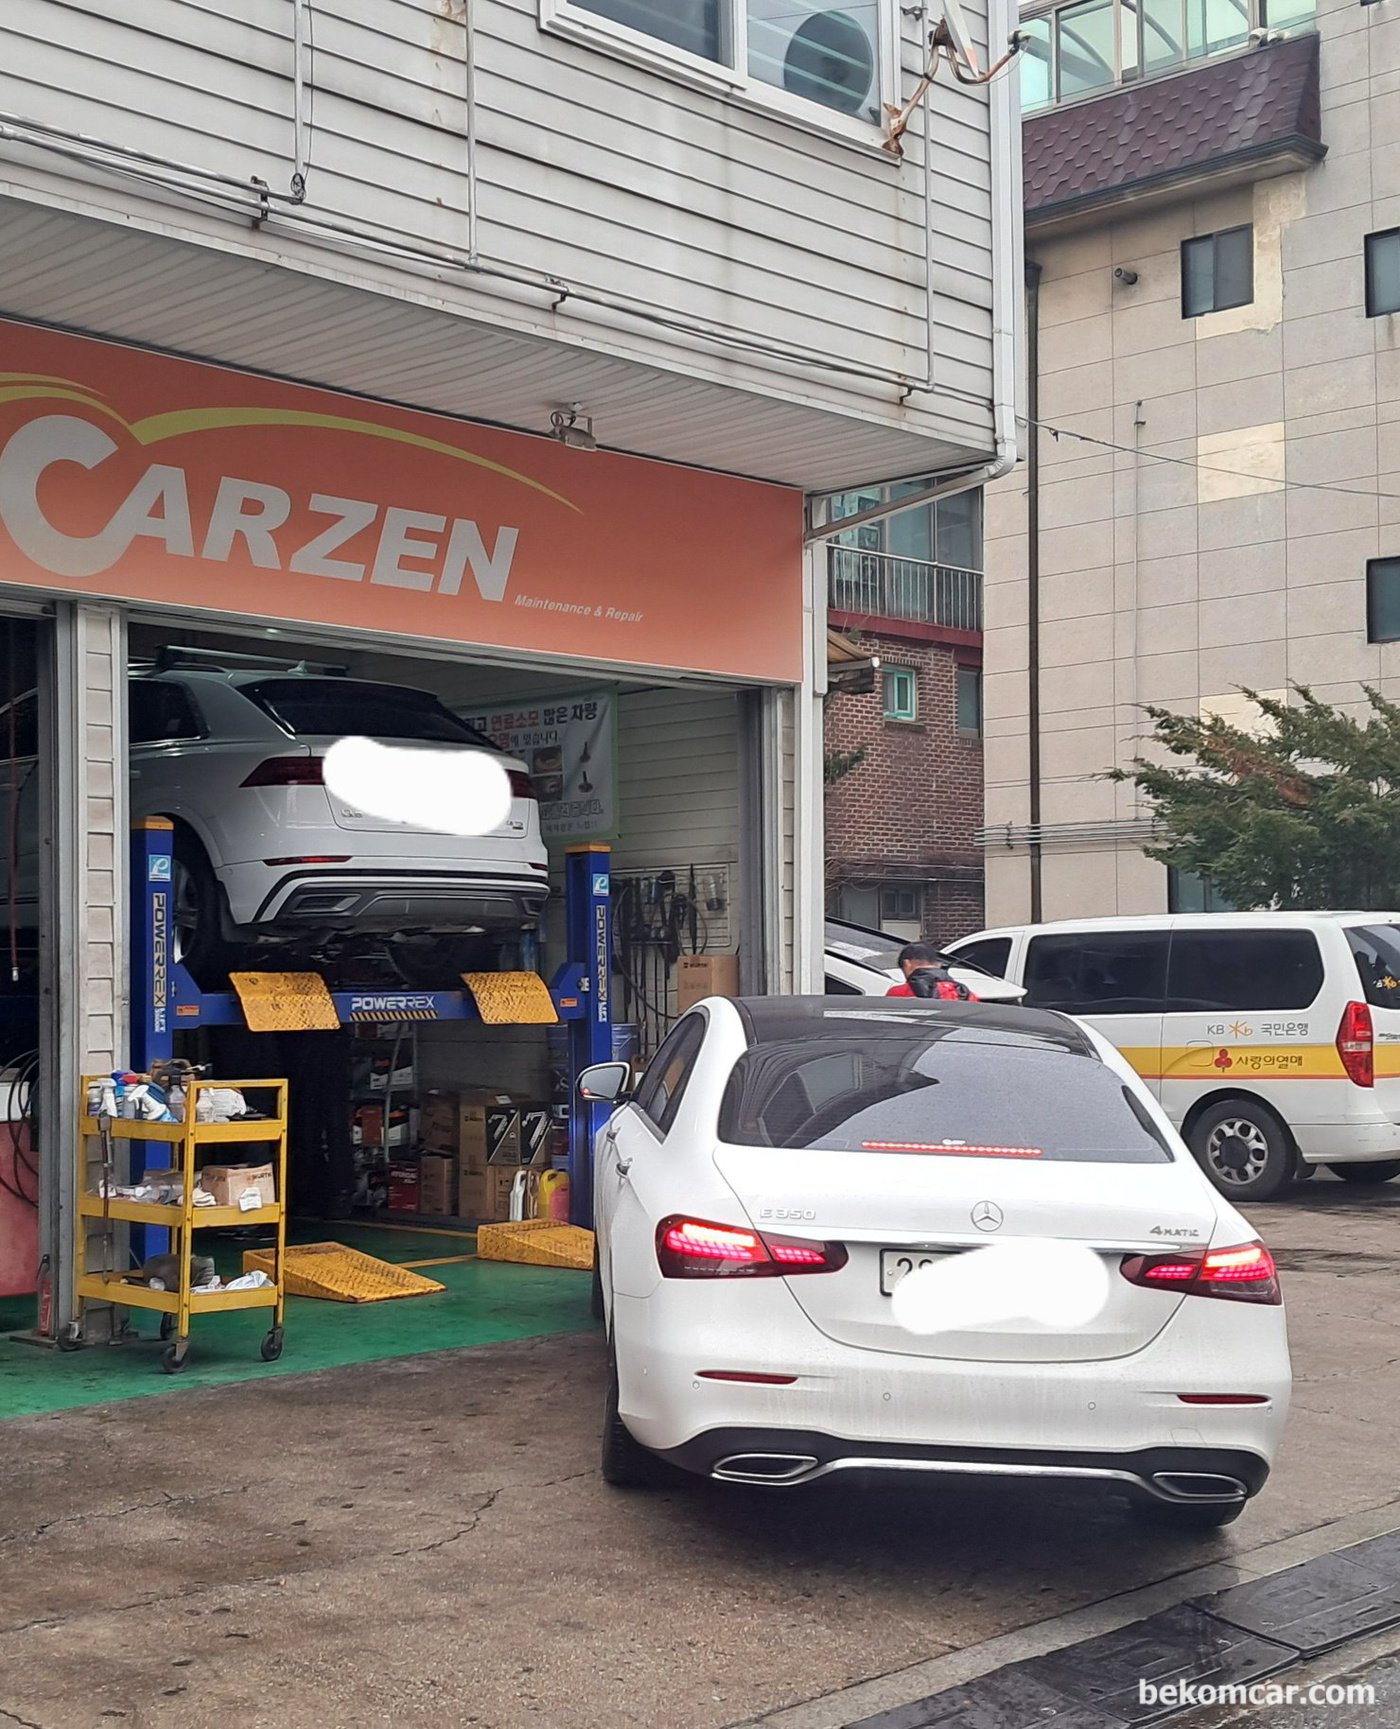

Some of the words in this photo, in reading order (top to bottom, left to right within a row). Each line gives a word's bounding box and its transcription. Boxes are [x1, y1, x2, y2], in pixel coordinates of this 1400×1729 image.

[0, 415, 519, 602] CARZEN
[515, 594, 592, 616] Maintenance
[594, 605, 603, 617] &
[605, 607, 643, 622] Repair
[543, 707, 568, 726] 많은
[571, 702, 598, 721] 차량
[154, 893, 166, 1006] POWERREX
[351, 995, 435, 1011] POWERREX
[1206, 1025, 1225, 1035] KB
[1260, 1022, 1309, 1036] 국민은행
[1235, 1054, 1304, 1070] 사랑의열매
[1149, 1225, 1200, 1237] 4MATIC
